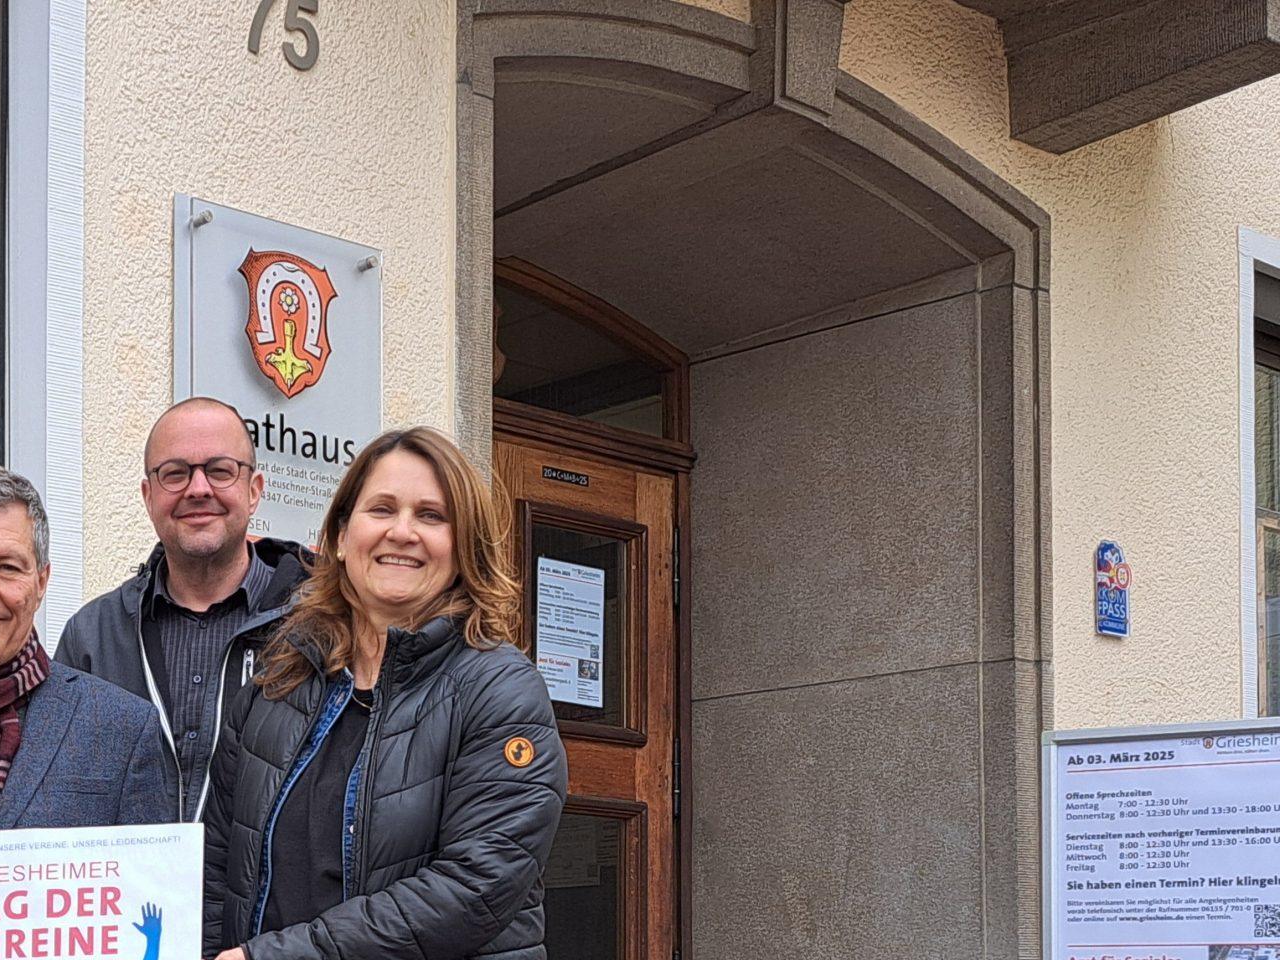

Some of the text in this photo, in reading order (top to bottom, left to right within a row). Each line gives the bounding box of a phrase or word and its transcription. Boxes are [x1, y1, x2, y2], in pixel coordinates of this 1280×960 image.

[244, 413, 355, 466] athaus
[271, 464, 284, 474] der
[286, 466, 308, 480] Stadt
[309, 471, 340, 486] Grieshe
[265, 477, 334, 498] -Leuschner-Straß
[260, 490, 324, 510] 4347 Griesheim
[1067, 751, 1174, 766] Ab 03. März 2025
[1065, 789, 1152, 800] Offene Sprechzeiten
[1065, 797, 1188, 811] Montag 7:00 12:30 Uhr
[1066, 812, 1115, 821] Donnerstag
[1119, 810, 1139, 818] 8:00
[1146, 809, 1171, 817] 12:30
[1173, 808, 1190, 816] Uhr
[1192, 807, 1209, 815] und
[1211, 806, 1237, 815] 13:30
[1245, 805, 1271, 813] 18:00
[1065, 826, 1280, 840] Servicezeiten nach vorheriger Terminvereinbarun
[29, 840, 69, 850] VEREINE.
[72, 839, 108, 848] UNSERE
[111, 835, 181, 846] LEIDENSCHAFT!
[1066, 843, 1104, 852] Dienstag
[1119, 841, 1139, 849] 8:00
[1146, 840, 1171, 848] 12:30
[1173, 839, 1190, 848] Uhr
[1192, 838, 1209, 847] und
[1211, 838, 1237, 846] 13:30
[1245, 837, 1271, 845] 16:00
[1066, 853, 1107, 861] Mittwoch
[1146, 851, 1171, 859] 12:30
[1173, 849, 1190, 858] Uhr
[1066, 860, 1190, 873] Freitag 8:00 12:30 Uhr
[1067, 874, 1280, 890] Sie haben einen Termin? Hier klingel
[46, 886, 122, 918] DER
